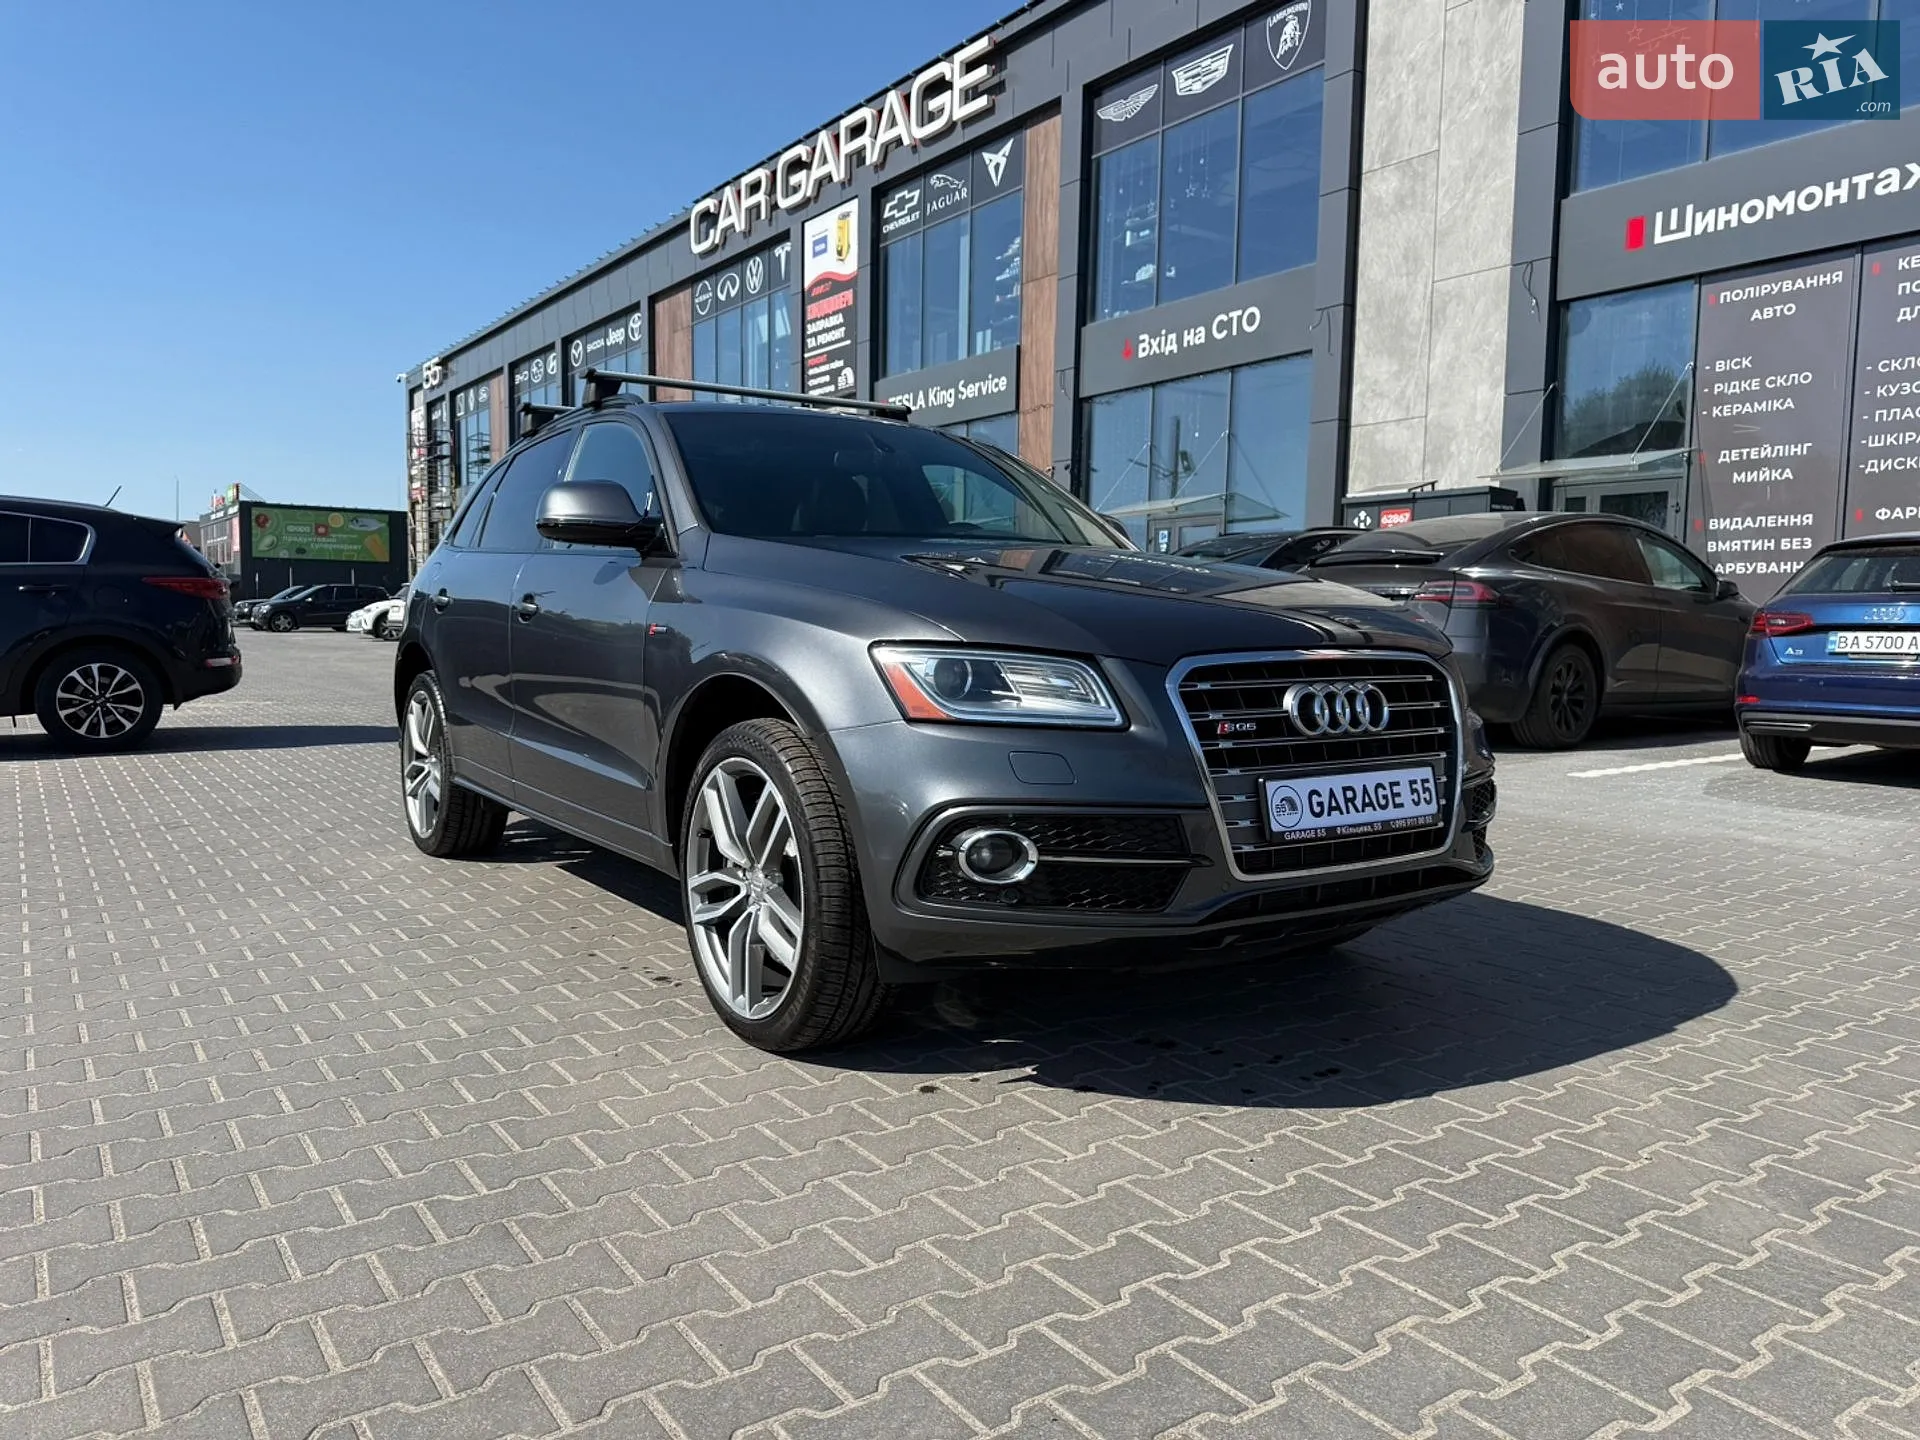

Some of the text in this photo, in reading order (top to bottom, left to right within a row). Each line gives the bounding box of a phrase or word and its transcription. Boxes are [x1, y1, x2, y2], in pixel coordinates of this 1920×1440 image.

[690, 35, 994, 254] CAR GARAGE
[926, 187, 968, 216] JAGUAR
[883, 211, 920, 234] CHEVROLET
[1718, 271, 1843, 304] ПОЛІРУВАННЯ
[1750, 302, 1796, 321] АВТО
[606, 327, 625, 346] Jeep
[1137, 306, 1261, 358] Вхід на СТО
[422, 357, 442, 389] 55
[1715, 356, 1753, 372] ВІСК
[929, 385, 954, 408] King
[958, 373, 1008, 400] Service
[1714, 372, 1812, 397] РІДКЕ СКЛО
[1712, 398, 1795, 418] КЕРАМІКА
[1718, 442, 1812, 464] ДЕТЕЙЛІНГ
[1733, 466, 1793, 485] МИЙКА
[1709, 513, 1814, 531] ВИДАЛЕННЯ
[1875, 506, 1920, 521] ФАР
[1707, 536, 1812, 553] ВМЯТИН БЕЗ
[1864, 635, 1904, 650] 5700
[1308, 778, 1433, 818] GARAGE 55
[1284, 829, 1316, 840] GARAGE
